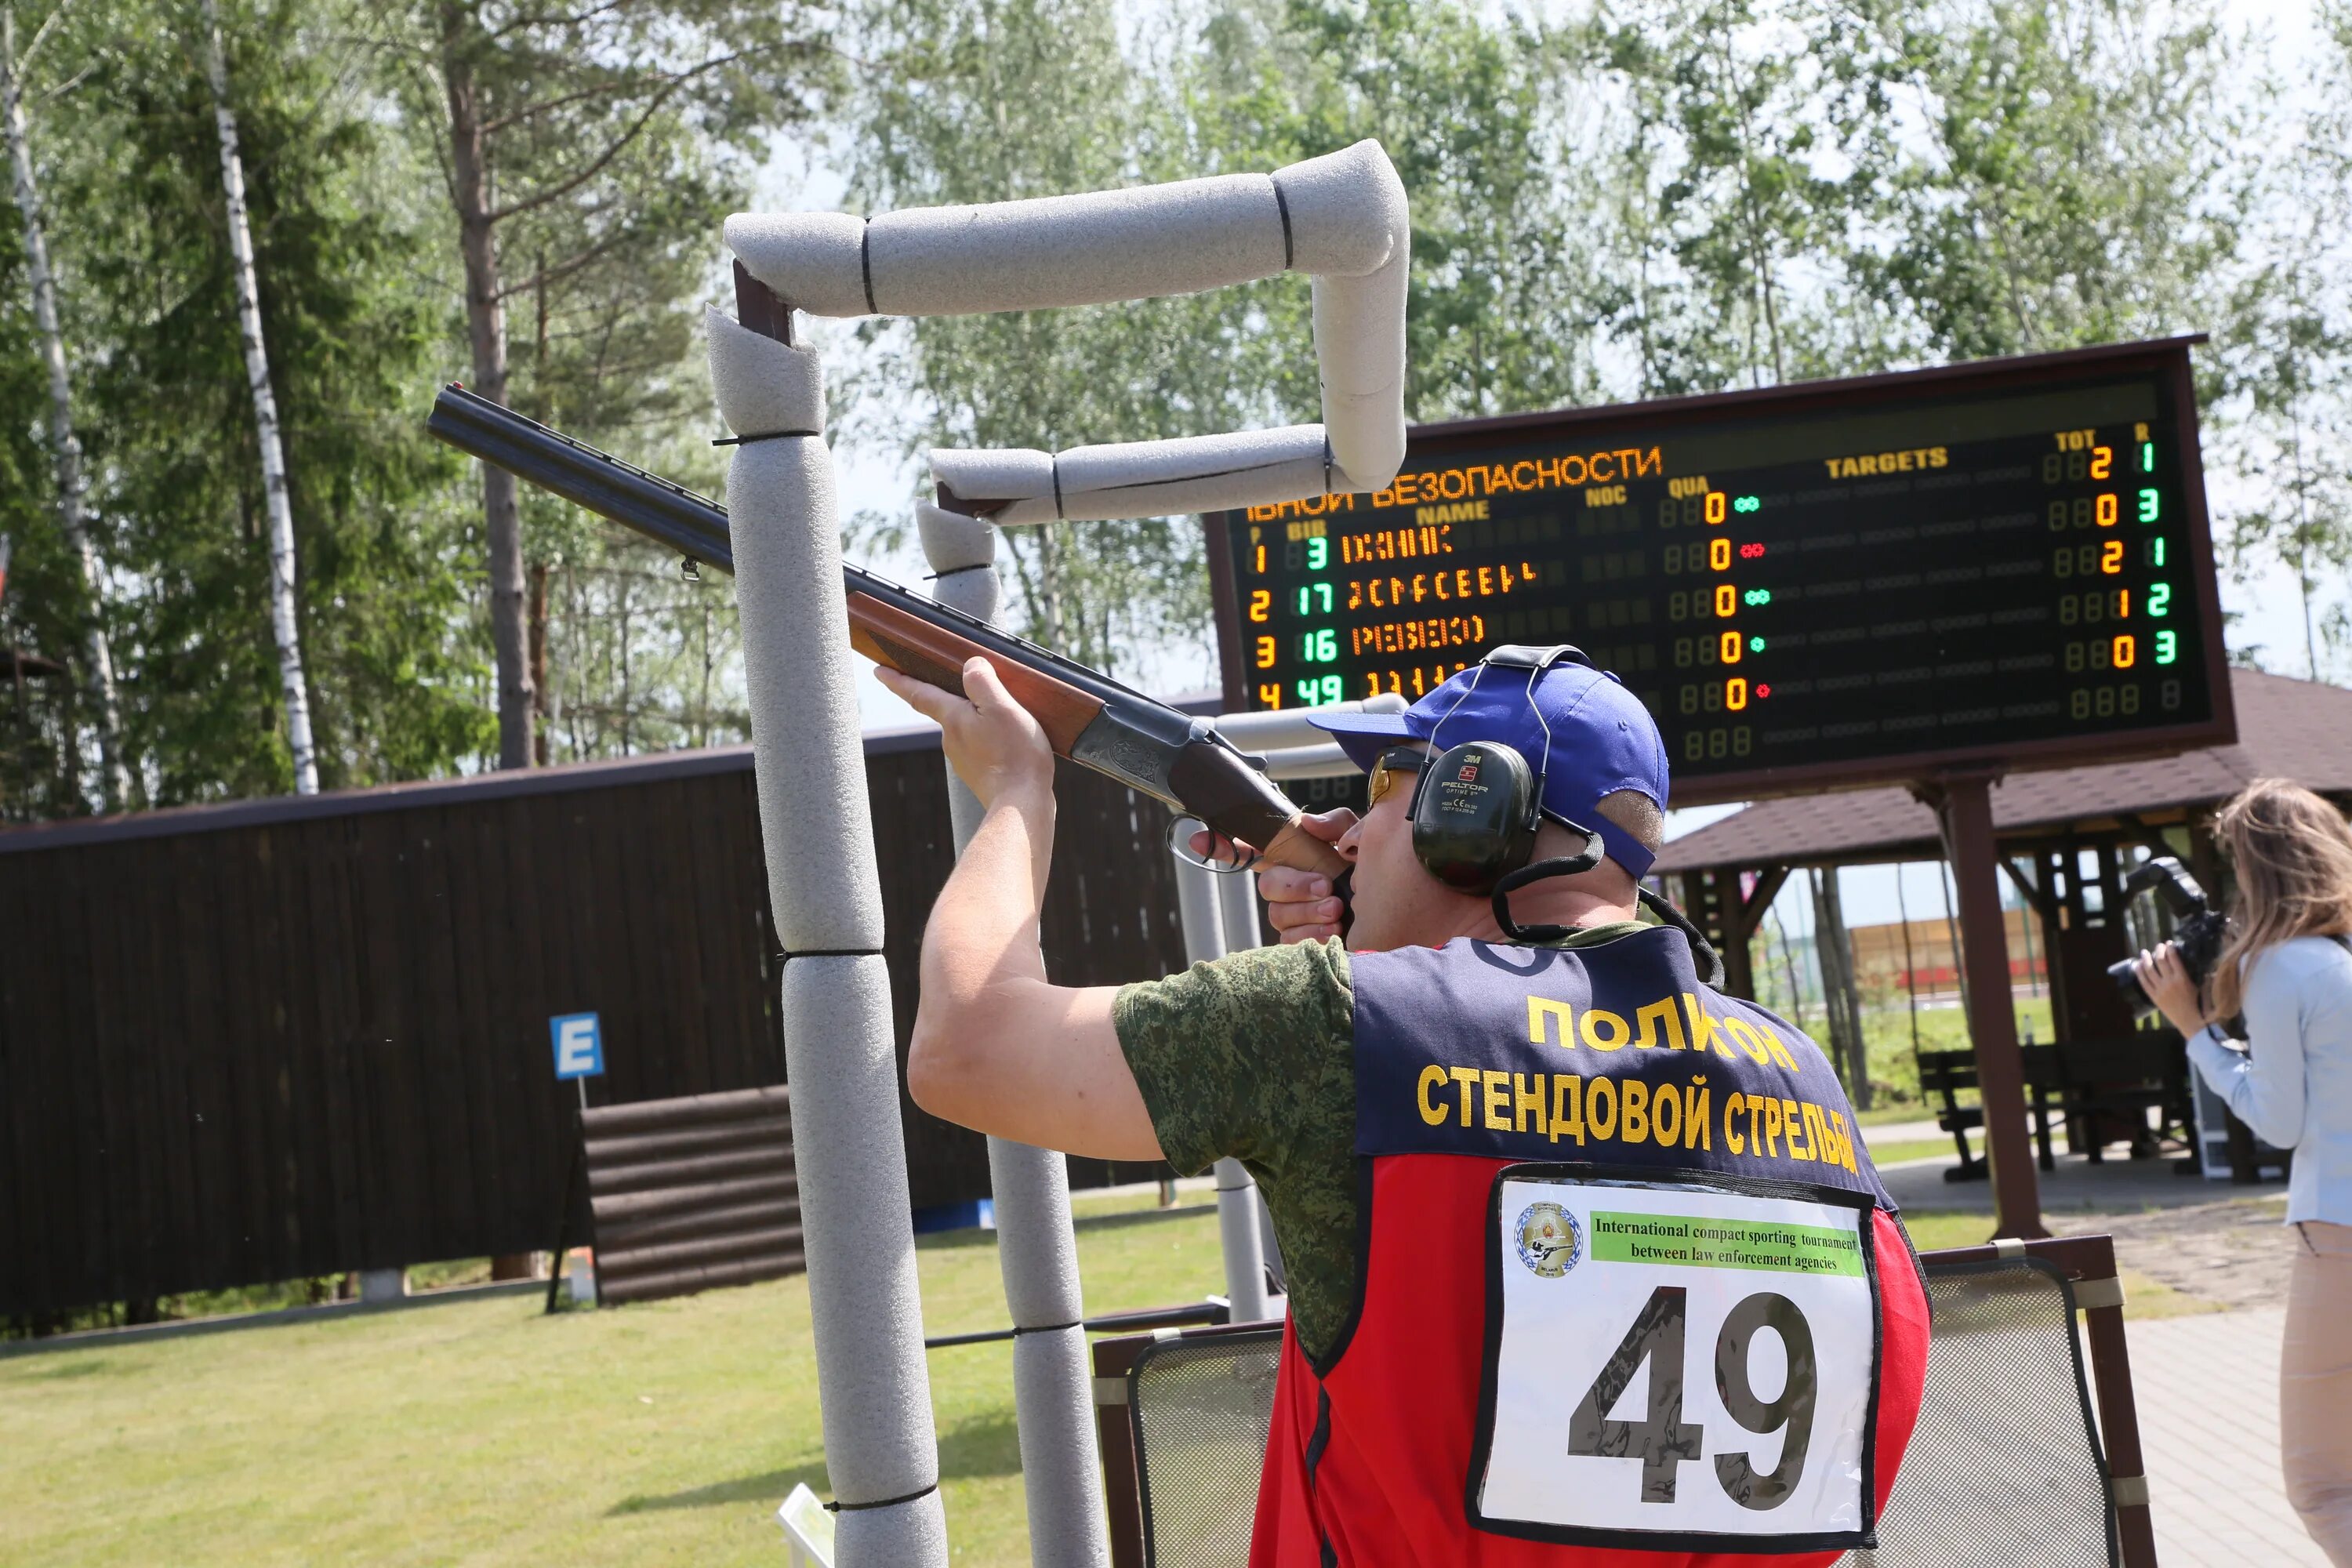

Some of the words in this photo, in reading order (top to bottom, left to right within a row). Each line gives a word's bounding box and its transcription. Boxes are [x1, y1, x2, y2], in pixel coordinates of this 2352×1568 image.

[2055, 429, 2096, 452] TOT
[2135, 422, 2151, 441] R
[1825, 446, 1949, 480] TARGETS
[2090, 446, 2112, 480] 2
[2143, 442, 2154, 472] 1
[1372, 445, 1663, 509] БЕЗОПАСНОСТИ
[1668, 475, 1709, 499] QUA
[1584, 484, 1628, 508] NOC
[1705, 492, 1726, 524] 0
[2096, 493, 2118, 527] 0
[2139, 488, 2160, 523] 3
[1416, 499, 1490, 527] NAME
[1287, 518, 1327, 542] BIB
[1257, 545, 1266, 574] 1
[1308, 536, 1328, 570] 3
[1710, 538, 1731, 571] 0
[2101, 541, 2123, 574] 2
[2154, 536, 2165, 566] 1
[1250, 590, 1271, 622] 2
[1299, 583, 1333, 616] 17
[1715, 585, 1737, 617] 0
[2120, 589, 2129, 618] 1
[2148, 583, 2170, 617] 2
[1256, 636, 1276, 669] 3
[1304, 629, 1338, 662] 16
[1721, 631, 1741, 663] 0
[2113, 635, 2135, 669] 0
[2155, 630, 2176, 664] 3
[1260, 682, 1280, 710] 4
[1297, 675, 1342, 706] 49
[1726, 678, 1747, 710] 0
[1463, 754, 1482, 764] 3M
[1441, 782, 1489, 793] PELTOR
[558, 1018, 594, 1073] E
[1417, 1064, 1711, 1151] СТЕНДОВОЙ
[1595, 1218, 1688, 1238] International
[1693, 1226, 1746, 1242] compact
[1748, 1229, 1797, 1247] sporting
[1802, 1232, 1857, 1250] tournament
[1631, 1243, 1687, 1261] between
[1692, 1247, 1715, 1261] law
[1718, 1249, 1791, 1267] enforcement
[1795, 1255, 1837, 1271] agencies
[1568, 1285, 1819, 1512] 49
